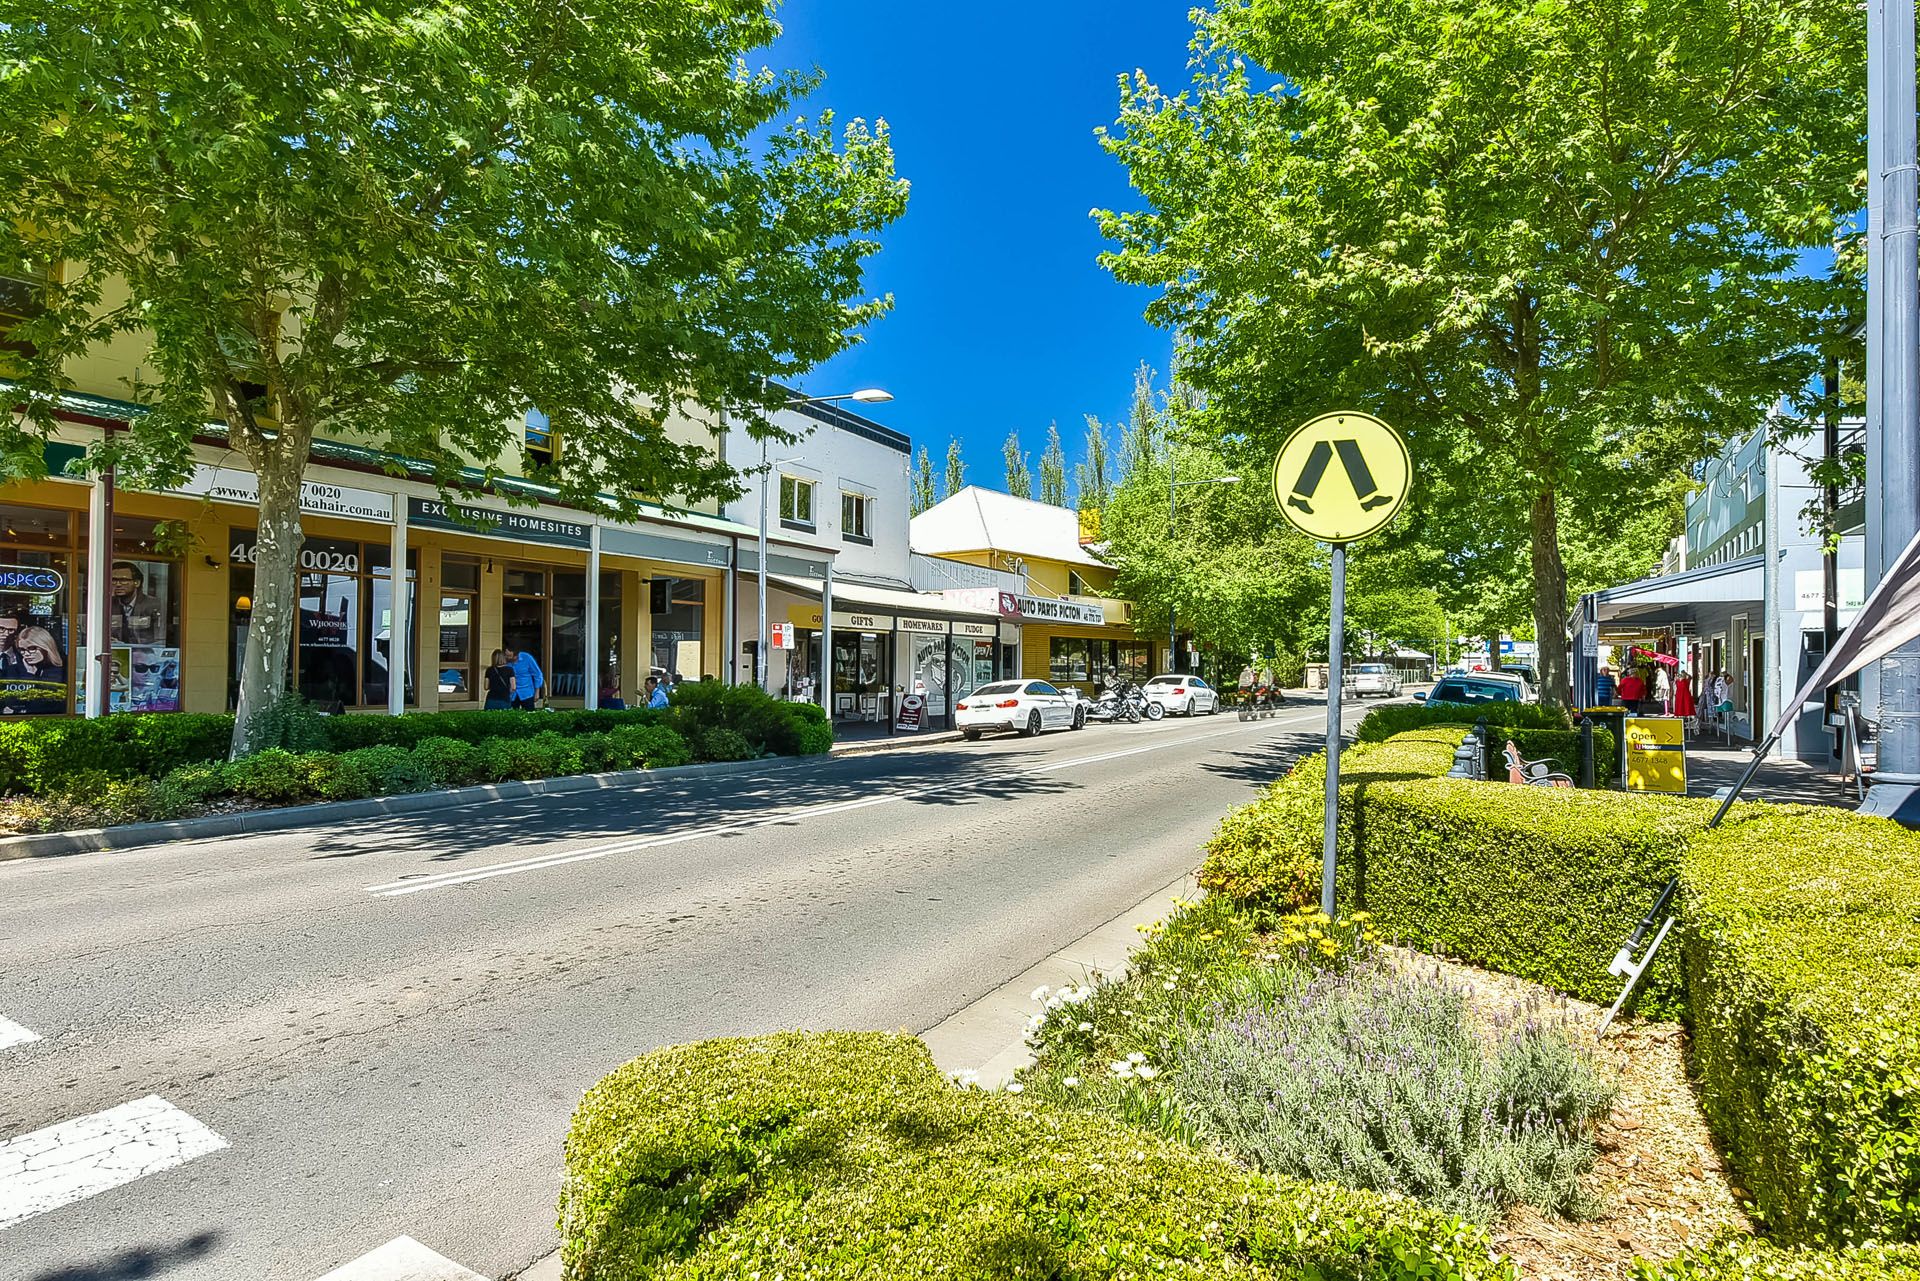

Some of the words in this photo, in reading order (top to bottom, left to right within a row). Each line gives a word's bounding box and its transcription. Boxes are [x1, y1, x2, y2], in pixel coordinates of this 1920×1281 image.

[311, 485, 341, 500] 0020
[421, 502, 503, 526] EXCUSIVE
[508, 516, 583, 536] HOMESITES
[229, 543, 257, 563] 46
[300, 550, 359, 573] 0020
[1017, 598, 1036, 615] AUTO
[1037, 600, 1058, 618] PARTS
[1059, 603, 1081, 620] PICTON
[850, 615, 874, 627] GIFTS
[902, 619, 944, 632] HOMEWARES
[964, 624, 984, 634] FUDGE
[917, 644, 933, 666] AUTO
[1631, 732, 1657, 742] Open
